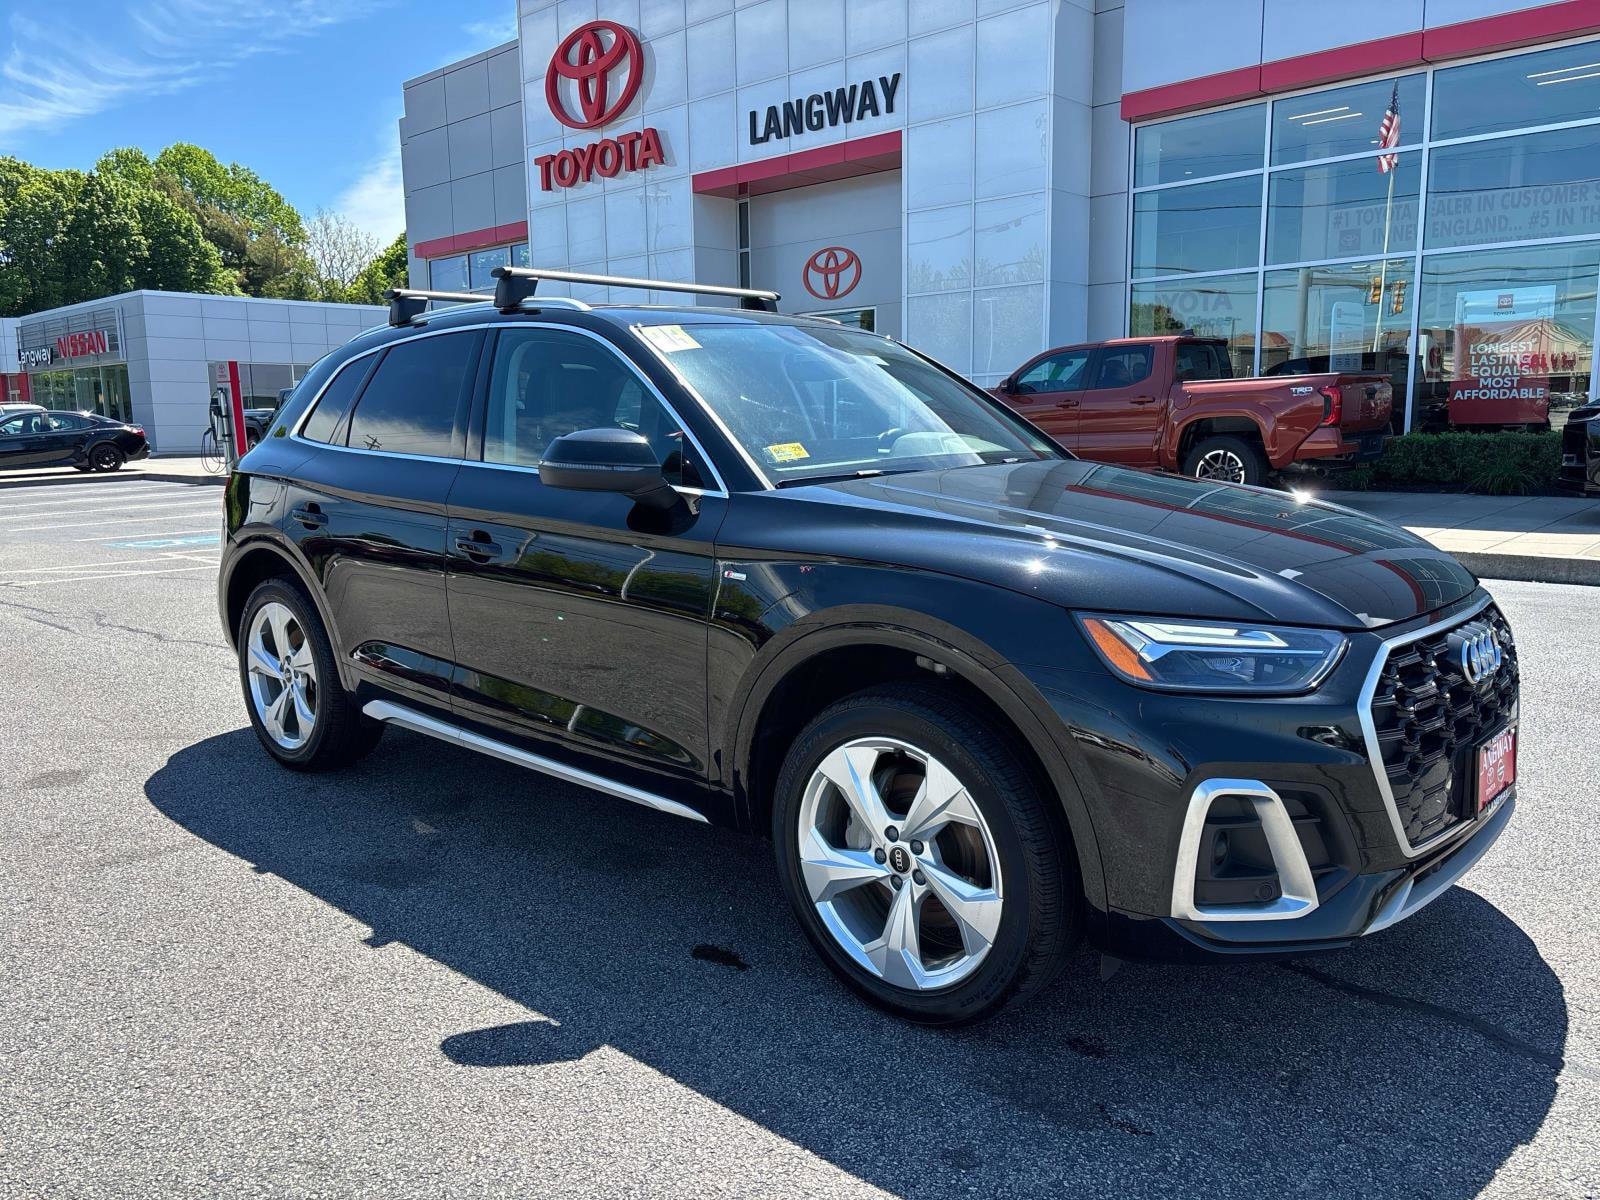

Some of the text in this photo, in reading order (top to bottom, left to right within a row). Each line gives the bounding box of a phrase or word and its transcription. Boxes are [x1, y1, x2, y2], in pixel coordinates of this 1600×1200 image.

[749, 73, 901, 145] LANGWAY
[534, 127, 665, 191] TOYOTA
[1356, 202, 1411, 225] TOYTA
[1477, 193, 1495, 213] IN
[1501, 184, 1588, 210] CUSTOMER
[1391, 222, 1418, 244] NE
[1431, 214, 1522, 238] ENGLAND...
[1528, 208, 1549, 230] #5
[1556, 206, 1575, 227] IN
[57, 330, 108, 359] NISSAN
[1471, 354, 1531, 366] LASTING
[1471, 365, 1530, 377] EQUALS
[1290, 386, 1313, 394] TRD
[1479, 377, 1520, 389] MOST
[1454, 388, 1545, 400] AFFORDABLE
